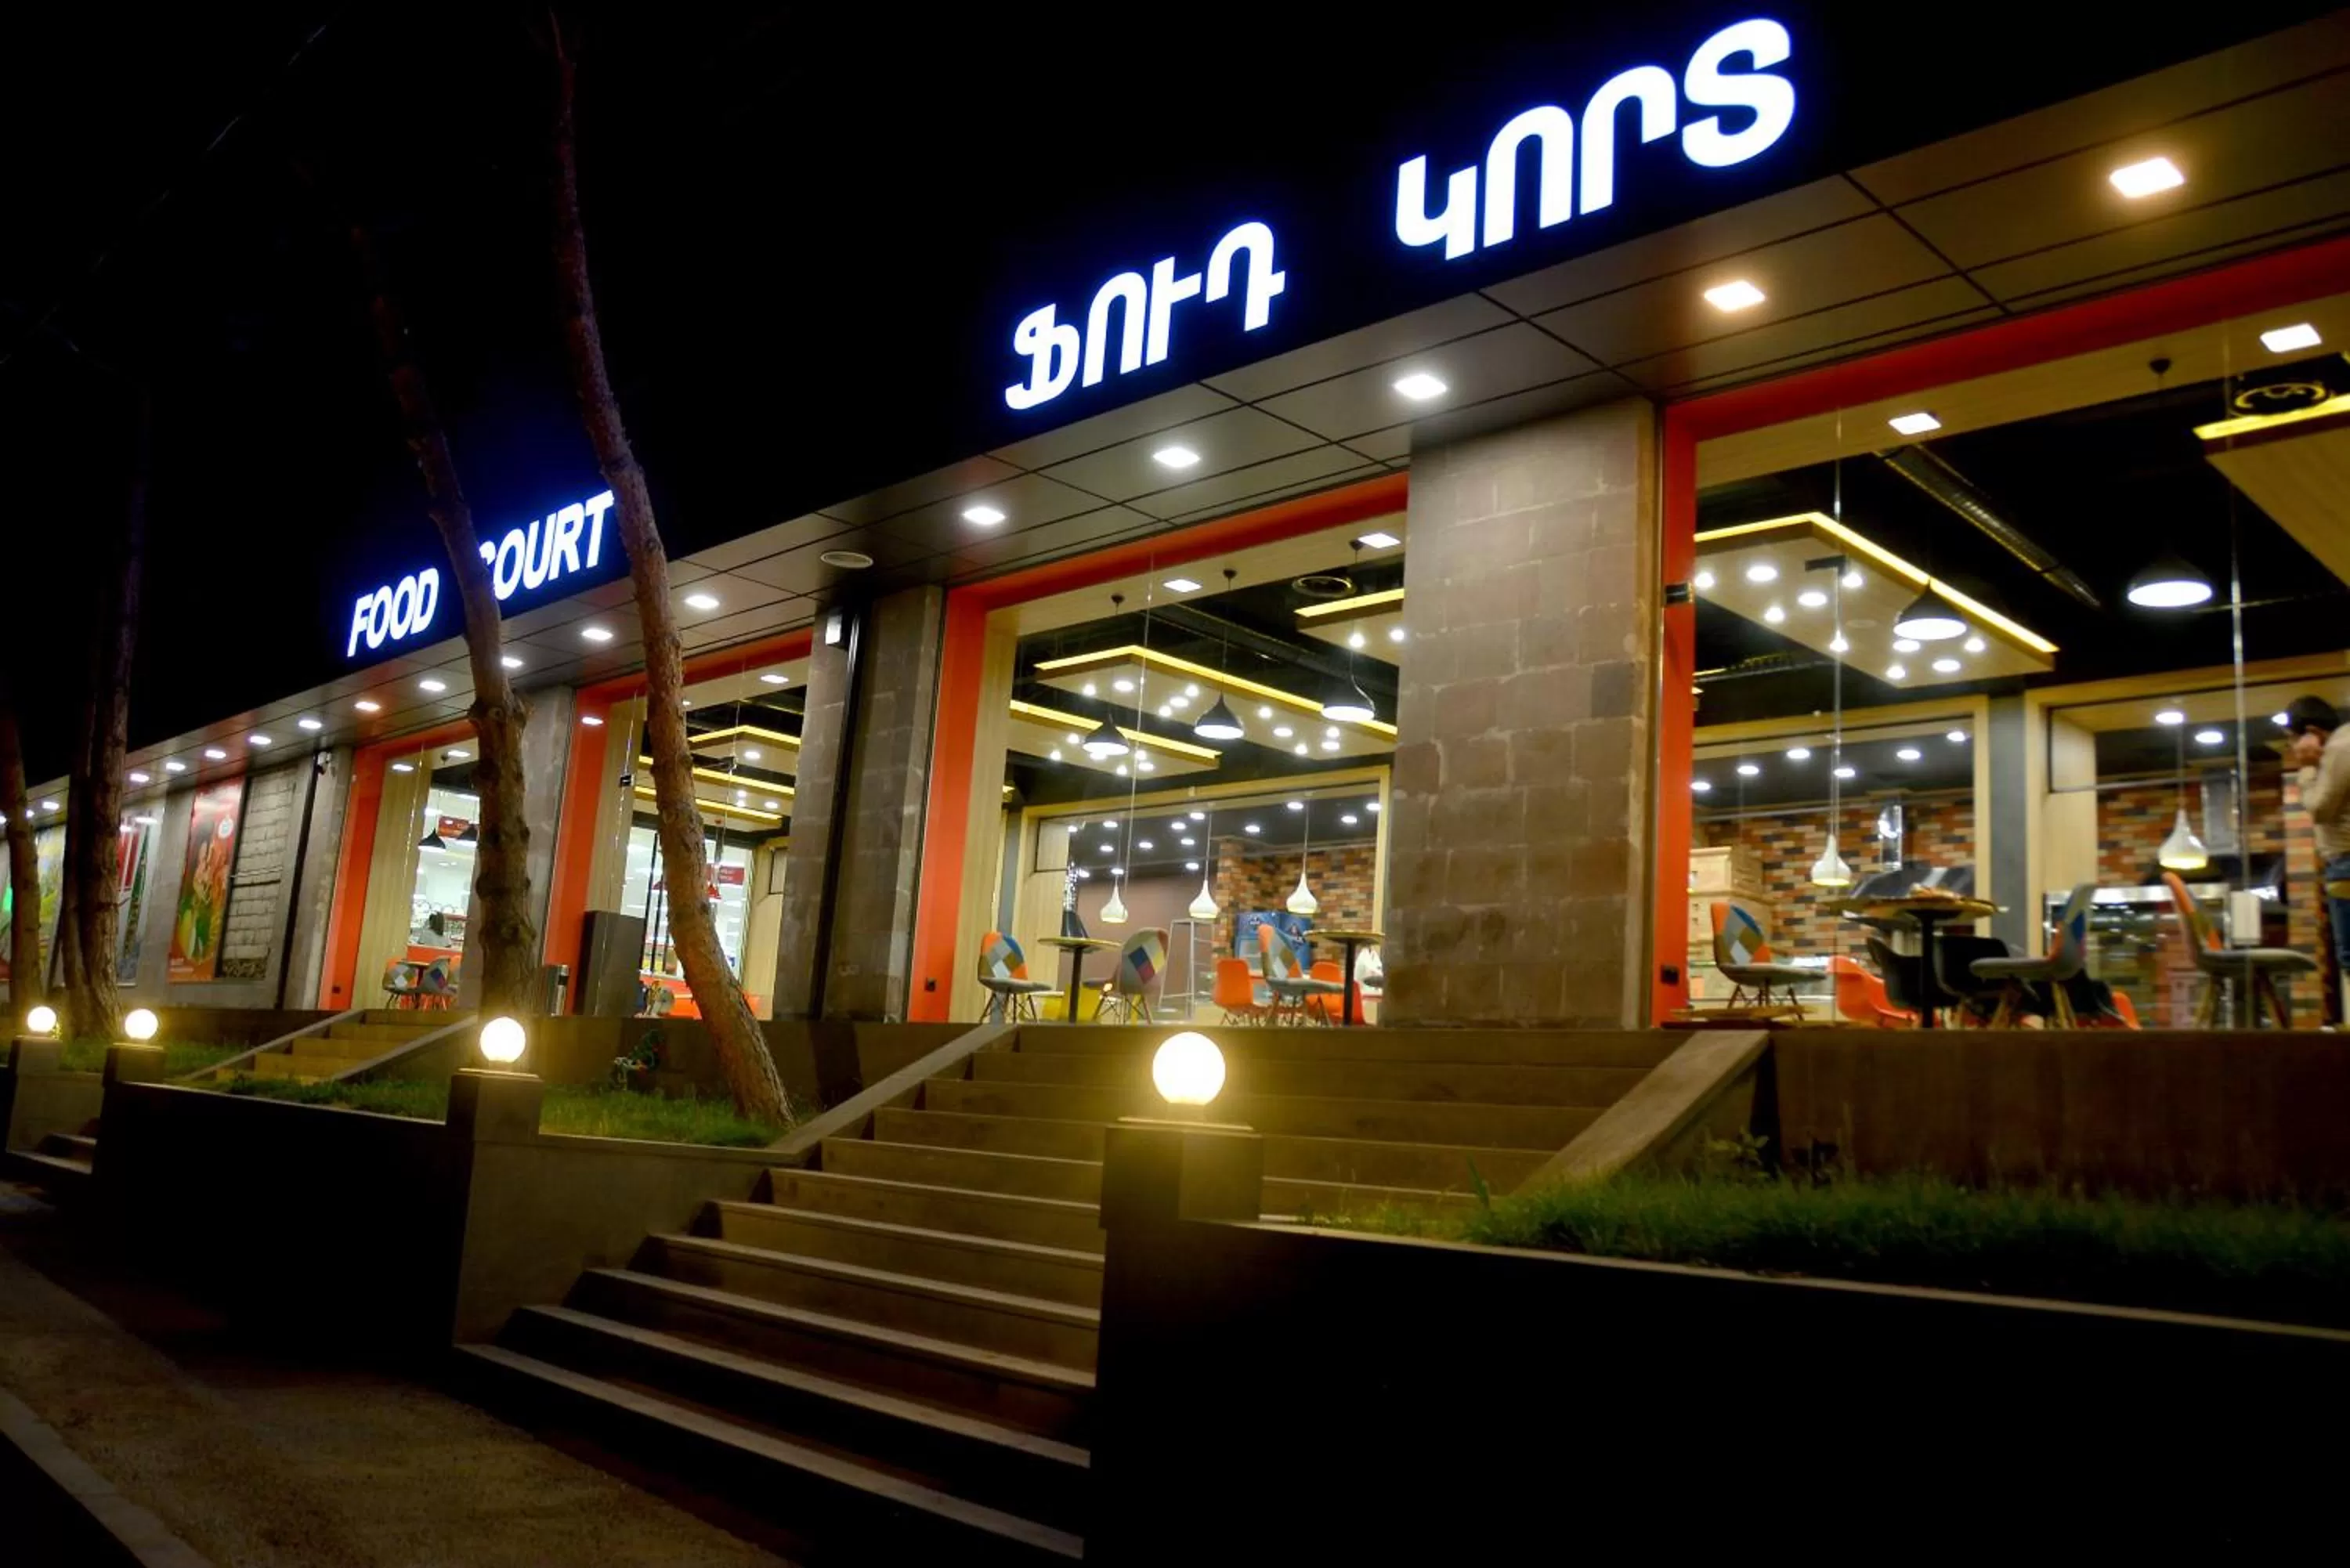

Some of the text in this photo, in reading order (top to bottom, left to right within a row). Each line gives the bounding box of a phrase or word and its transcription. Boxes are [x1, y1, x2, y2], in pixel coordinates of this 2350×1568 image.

[1005, 19, 1795, 410] ՖՈՒԴ ԿՈՐՏ
[347, 568, 439, 657] FOOD
